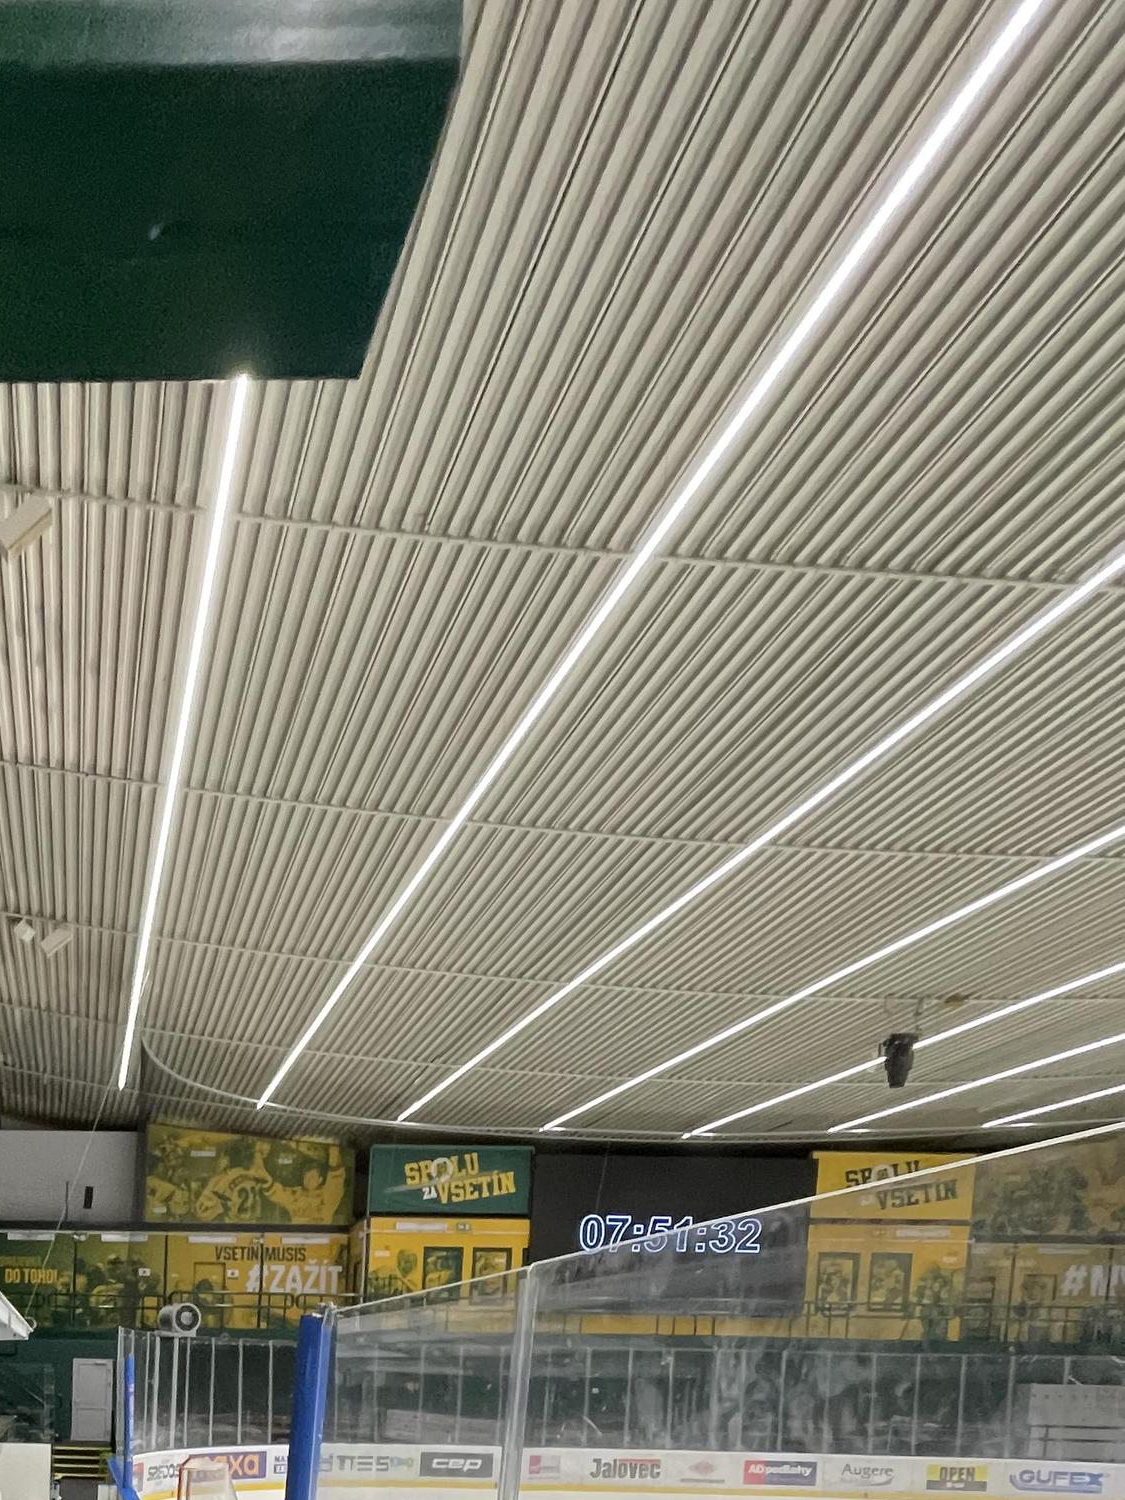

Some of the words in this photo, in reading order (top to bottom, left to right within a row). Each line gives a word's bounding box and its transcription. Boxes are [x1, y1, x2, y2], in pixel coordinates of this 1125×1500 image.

[579, 1213, 762, 1254] 07:51:32
[589, 1458, 661, 1479] Jalovec
[841, 1464, 893, 1478] Augere
